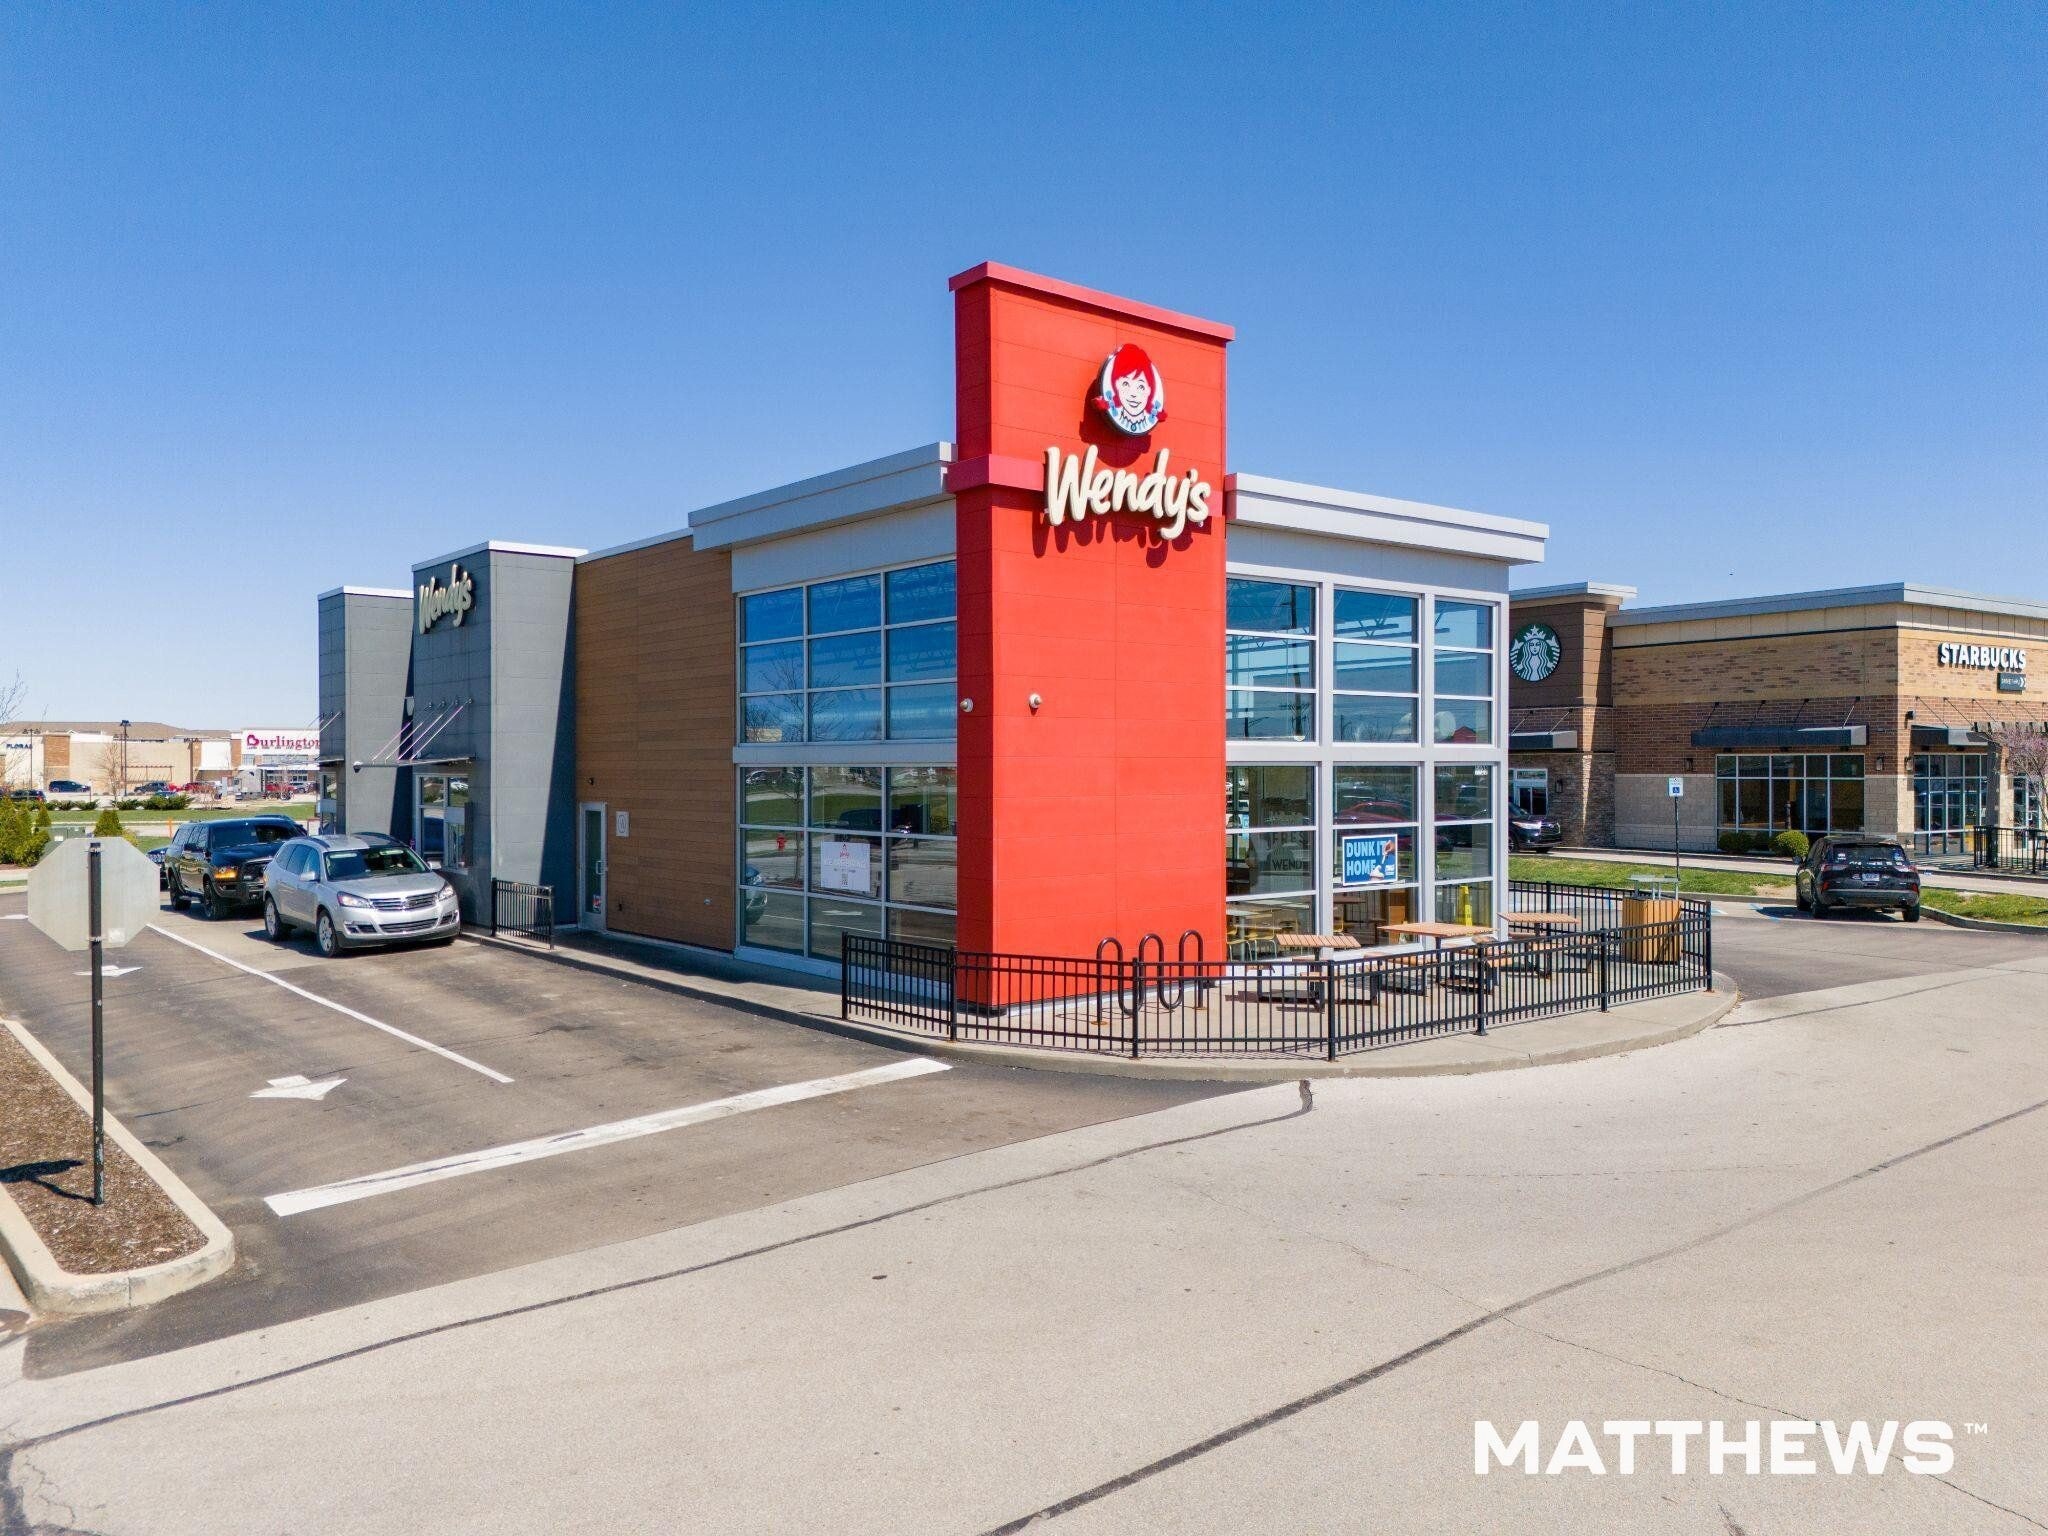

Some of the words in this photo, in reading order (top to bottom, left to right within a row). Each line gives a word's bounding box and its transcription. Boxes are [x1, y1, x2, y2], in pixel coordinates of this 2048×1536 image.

[1046, 444, 1211, 540] Wendy's
[418, 563, 472, 635] Wendy's
[1940, 642, 2027, 669] STARBUCKS
[1346, 841, 1375, 858] DUNK
[1346, 859, 1377, 876] HOME
